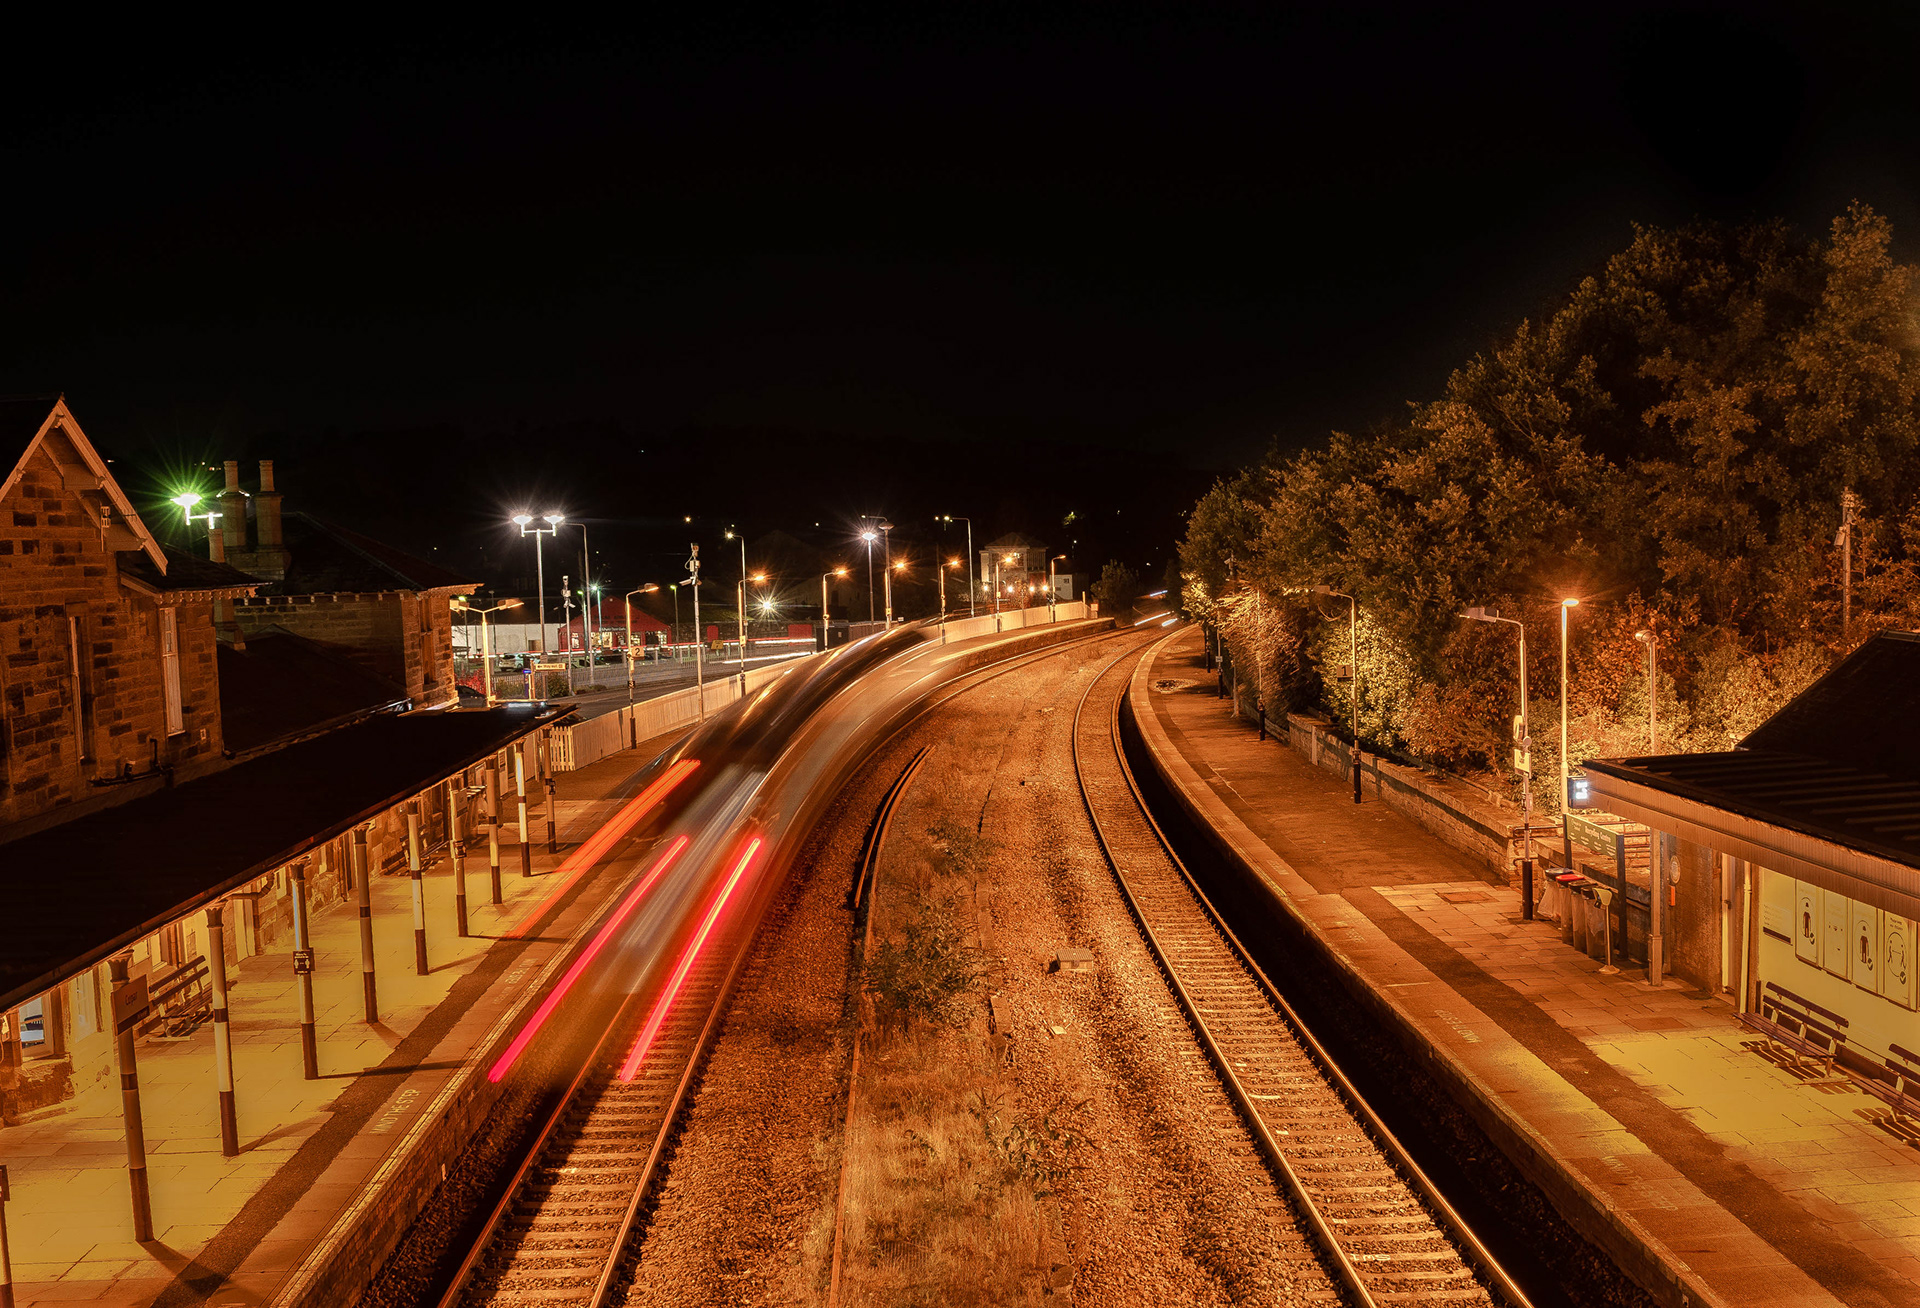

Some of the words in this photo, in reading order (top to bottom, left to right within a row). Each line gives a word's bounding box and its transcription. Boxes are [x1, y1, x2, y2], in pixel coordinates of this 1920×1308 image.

[635, 648, 641, 656] 2
[1341, 666, 1347, 676] 1
[395, 1089, 421, 1104] STEP
[383, 1104, 411, 1117] THE
[369, 1117, 399, 1134] MIND
